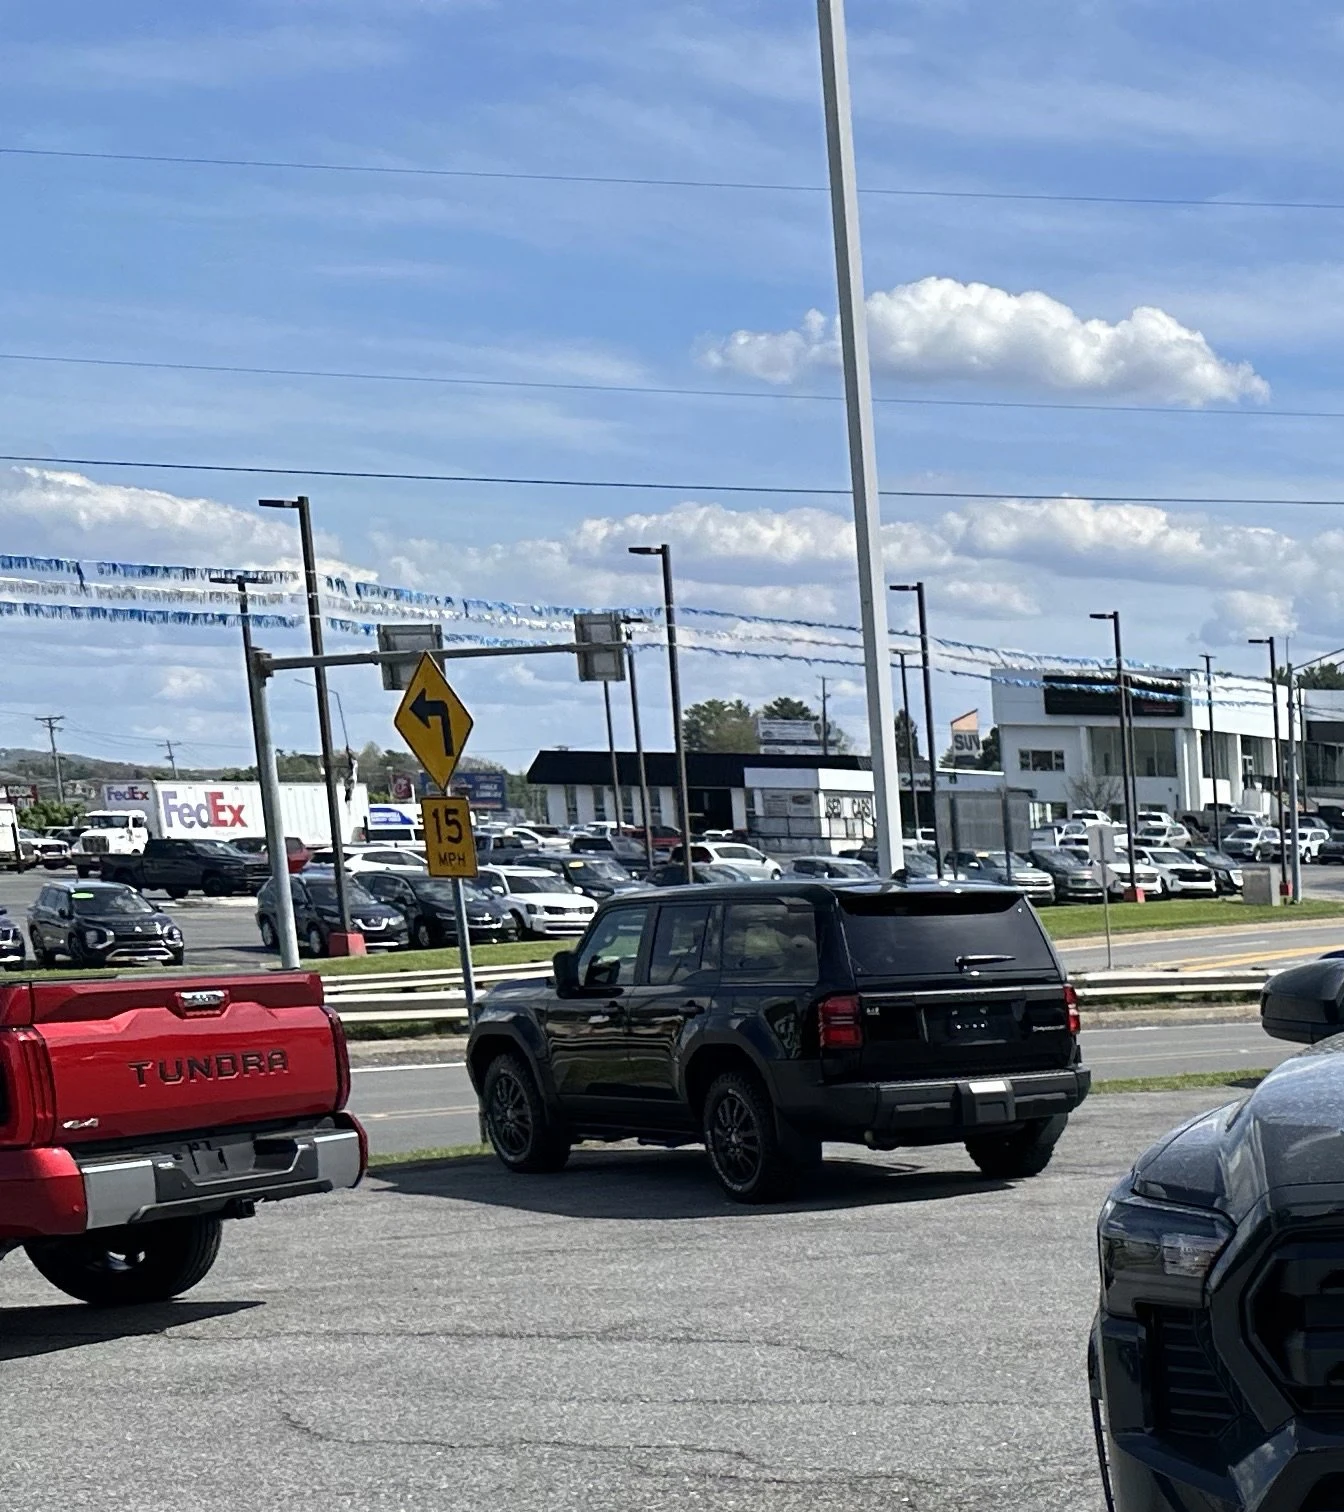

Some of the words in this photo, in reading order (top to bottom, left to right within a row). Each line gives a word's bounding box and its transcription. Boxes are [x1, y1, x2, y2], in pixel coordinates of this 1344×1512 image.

[107, 786, 149, 801] FedEx
[901, 777, 938, 787] Servic
[161, 790, 249, 829] FedEx
[432, 808, 463, 844] 15
[438, 852, 467, 867] MPH
[128, 1048, 290, 1088] TUNDRA
